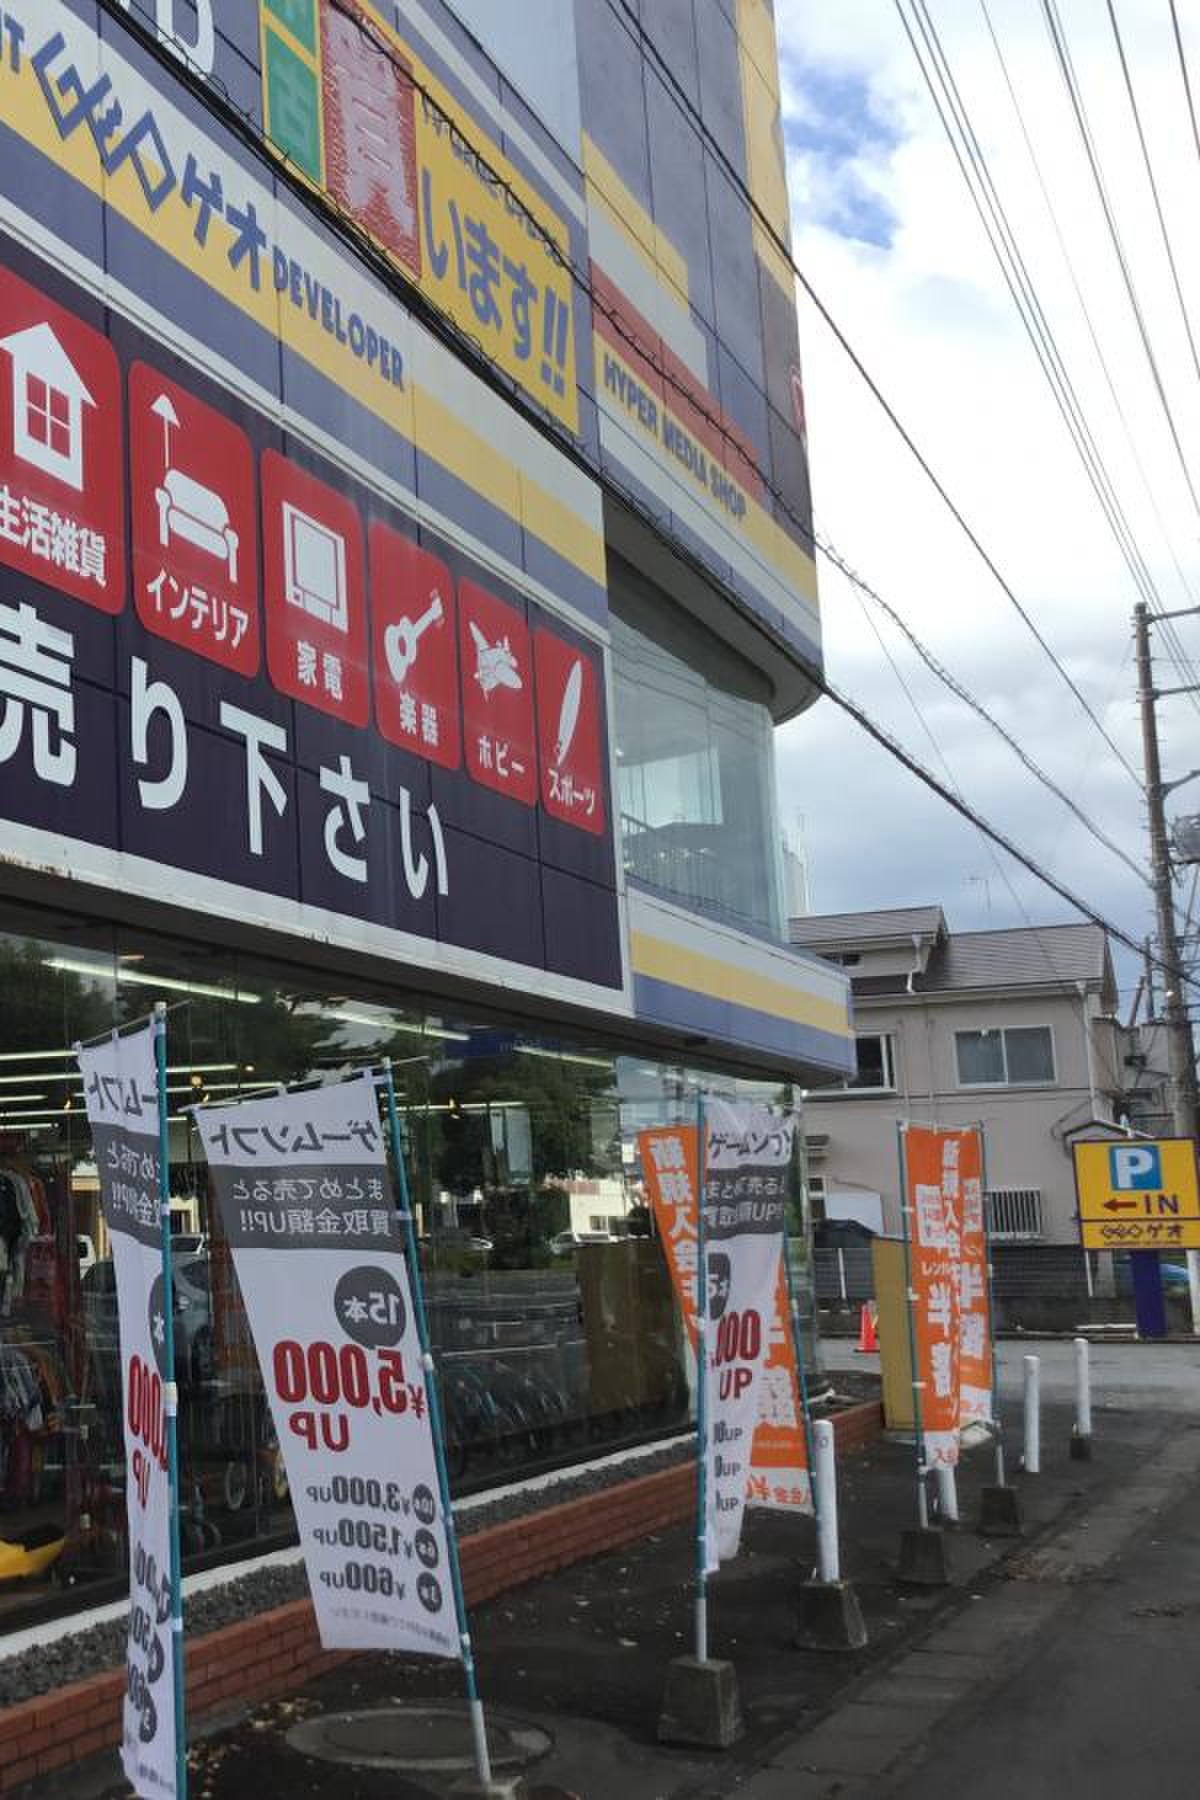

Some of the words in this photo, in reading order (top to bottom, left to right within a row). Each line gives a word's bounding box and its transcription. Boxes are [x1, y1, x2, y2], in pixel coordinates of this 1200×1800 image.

[181, 153, 267, 291] ゲオ
[272, 245, 405, 392] DEVELOPER
[604, 352, 659, 440] HYPER
[663, 413, 708, 487] MEDIA
[710, 463, 747, 522] SHOP
[146, 568, 249, 648] インテリア
[296, 640, 343, 701] 家電
[399, 691, 440, 747] 楽器
[478, 734, 526, 777] ホビー
[548, 767, 596, 816] スポーツ
[1115, 1148, 1153, 1188] P
[1143, 1194, 1179, 1214] IN
[719, 1367, 752, 1400] UP
